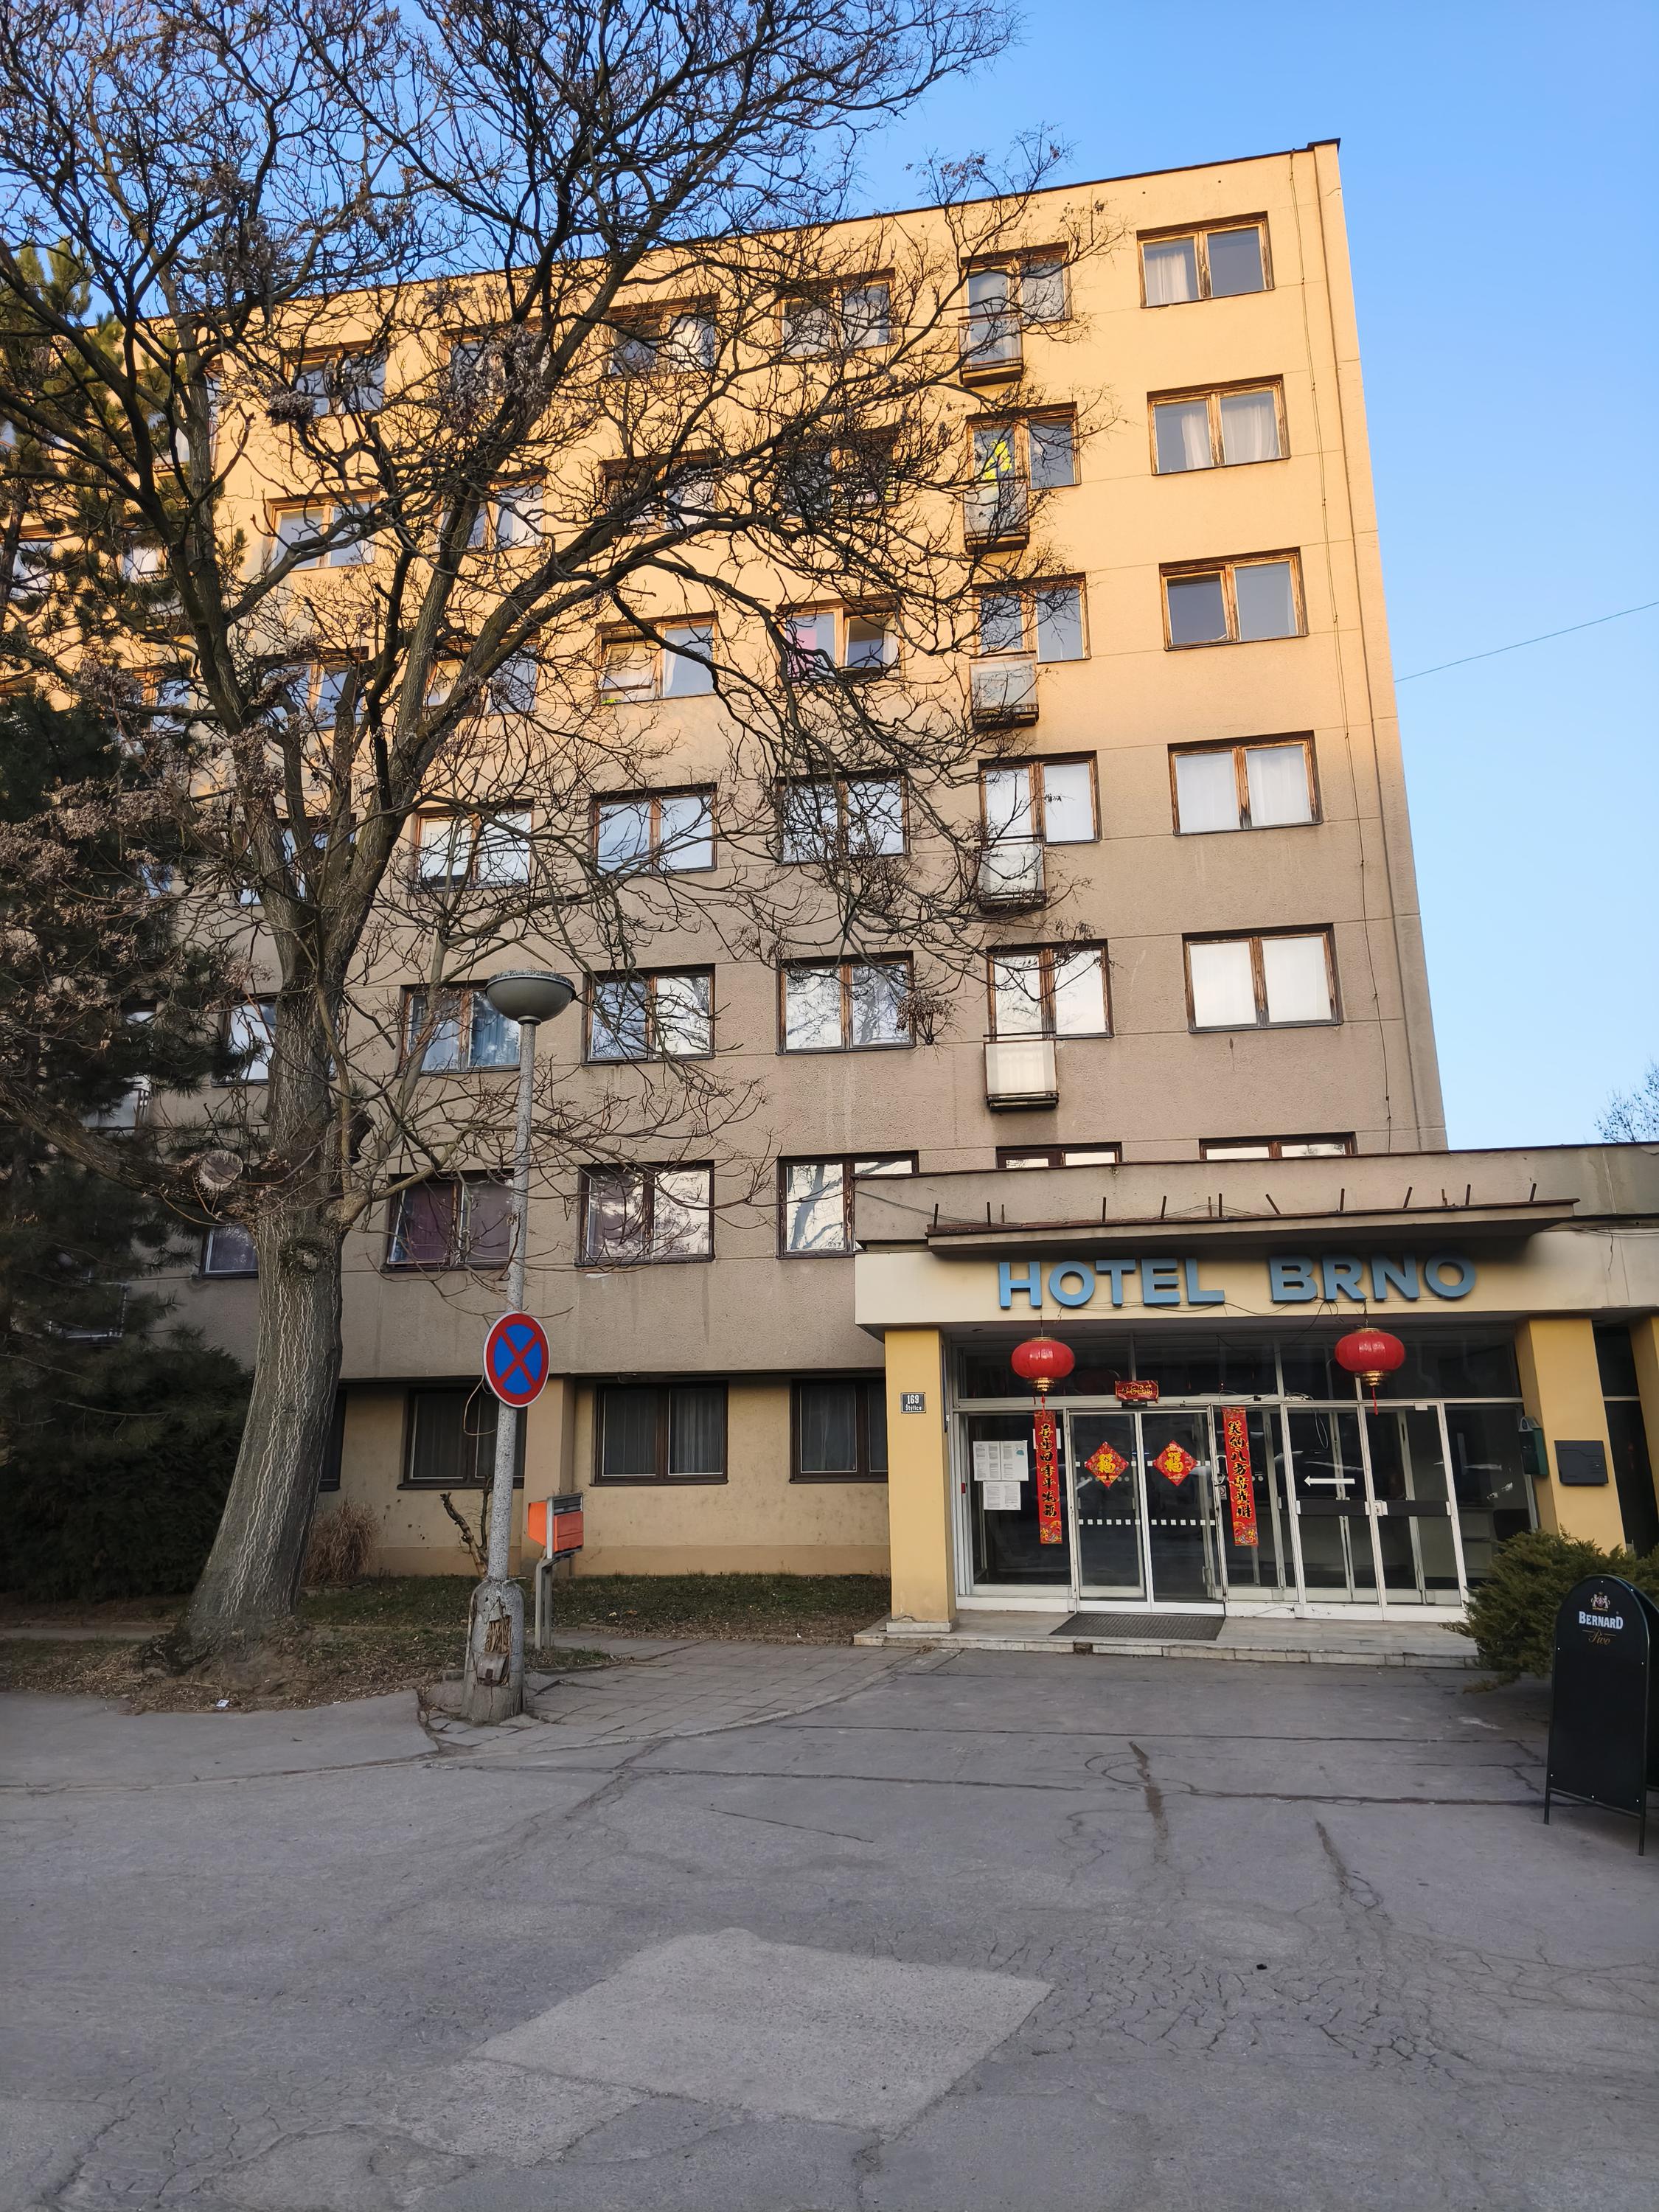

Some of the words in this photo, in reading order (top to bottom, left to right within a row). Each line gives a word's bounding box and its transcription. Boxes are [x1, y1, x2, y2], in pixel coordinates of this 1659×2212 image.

[999, 1259, 1225, 1309] HOTEL
[1270, 1254, 1476, 1302] BRNO
[907, 1394, 919, 1404] 169
[1579, 1611, 1624, 1630] BERNARD
